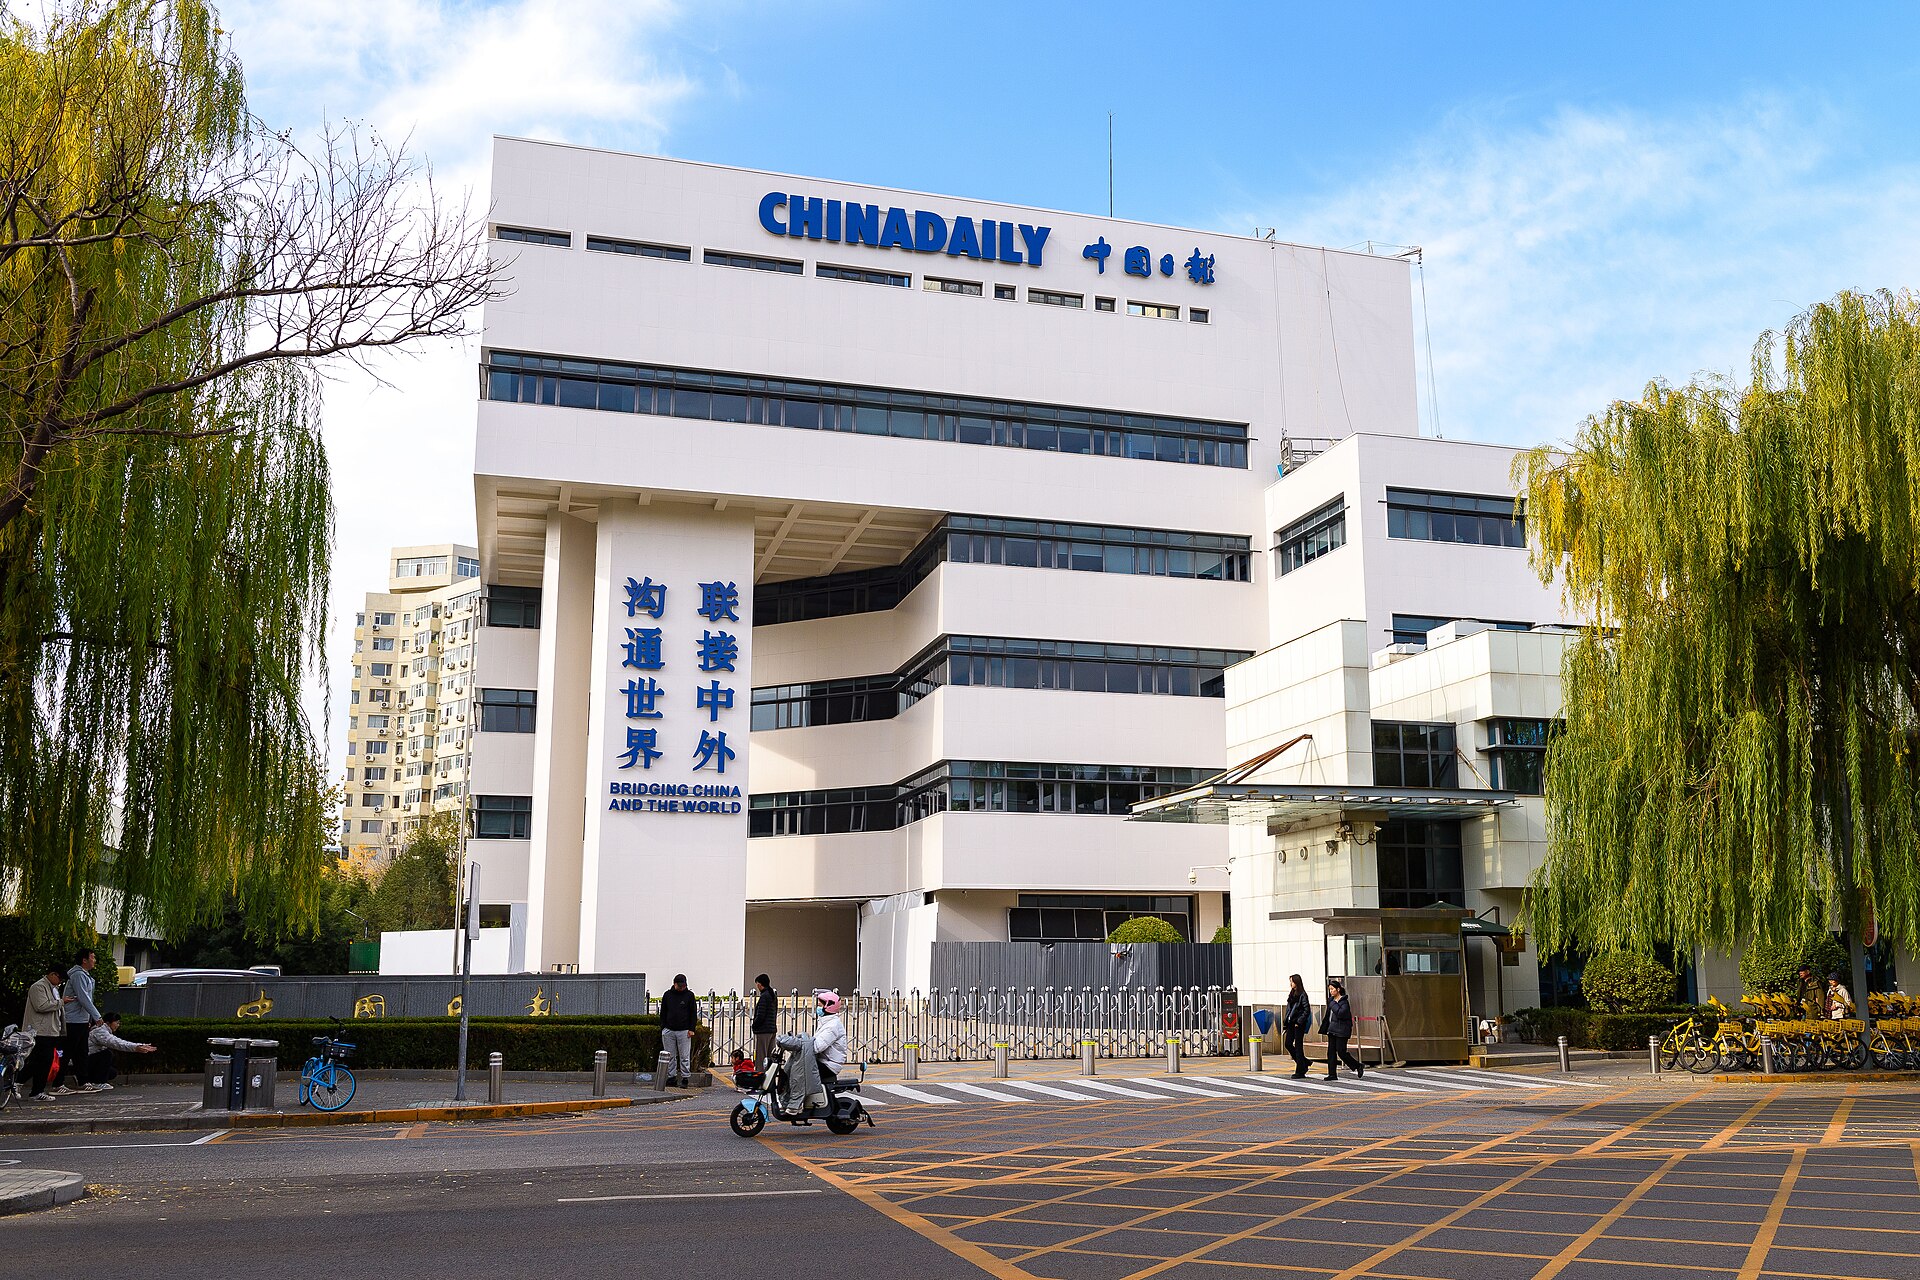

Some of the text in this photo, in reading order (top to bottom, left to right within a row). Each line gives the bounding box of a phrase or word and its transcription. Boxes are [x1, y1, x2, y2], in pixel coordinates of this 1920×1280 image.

[615, 576, 668, 770] 沟通世界
[692, 580, 740, 774] 联接中外
[608, 798, 743, 814] AND THE WORLD
[609, 782, 742, 798] BRIDGING CHINA
